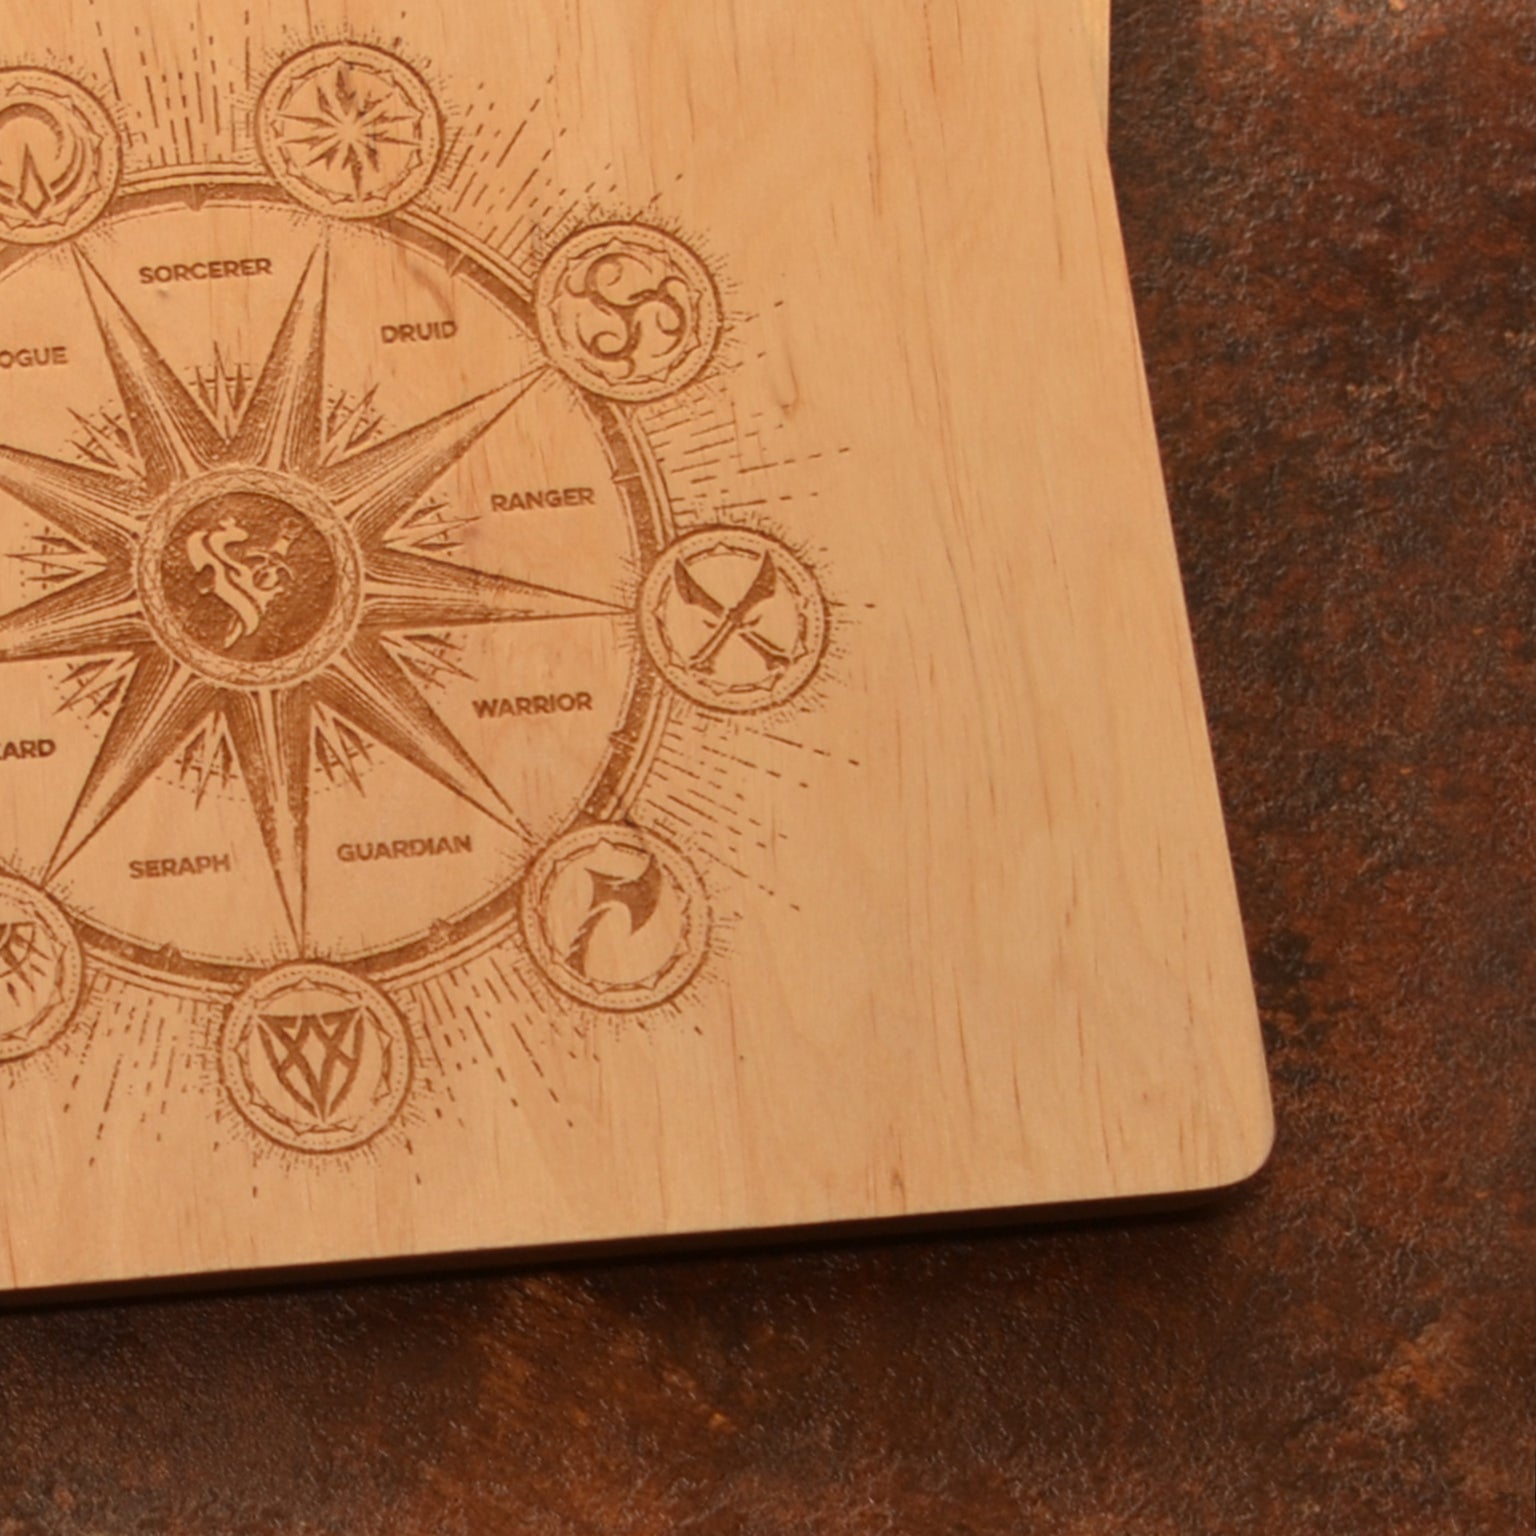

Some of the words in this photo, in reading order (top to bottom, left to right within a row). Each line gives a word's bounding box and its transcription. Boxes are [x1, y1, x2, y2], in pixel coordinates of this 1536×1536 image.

[138, 258, 272, 285] SORCERER
[379, 320, 458, 344] DRUID
[490, 486, 595, 514] RANGER
[472, 689, 593, 718] WARRIOR
[336, 834, 472, 861] GUARDIAN
[127, 852, 231, 879] SERAPH
